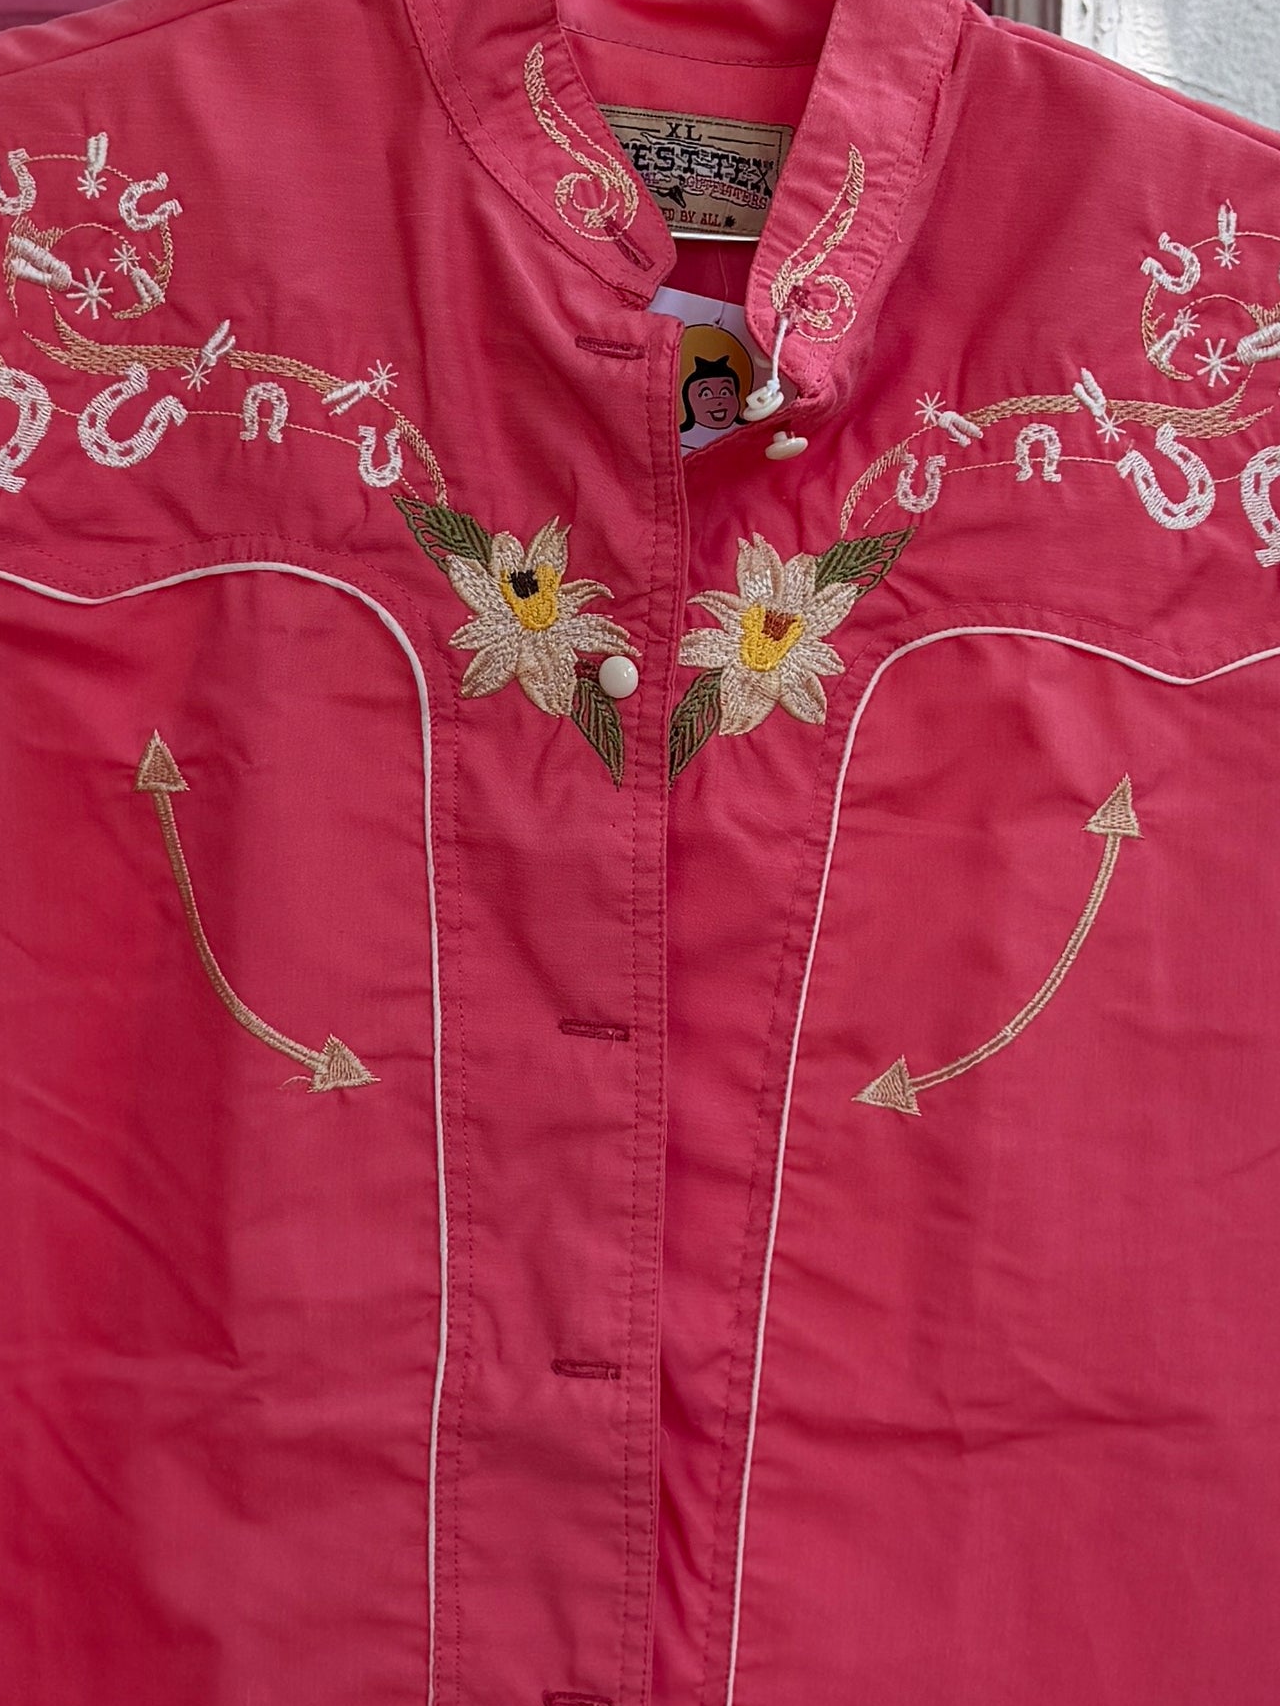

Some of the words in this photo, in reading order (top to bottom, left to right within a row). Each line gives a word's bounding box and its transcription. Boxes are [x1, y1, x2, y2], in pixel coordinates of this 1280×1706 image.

[665, 122, 703, 141] XL
[680, 210, 696, 223] BY
[700, 212, 721, 227] ALL
